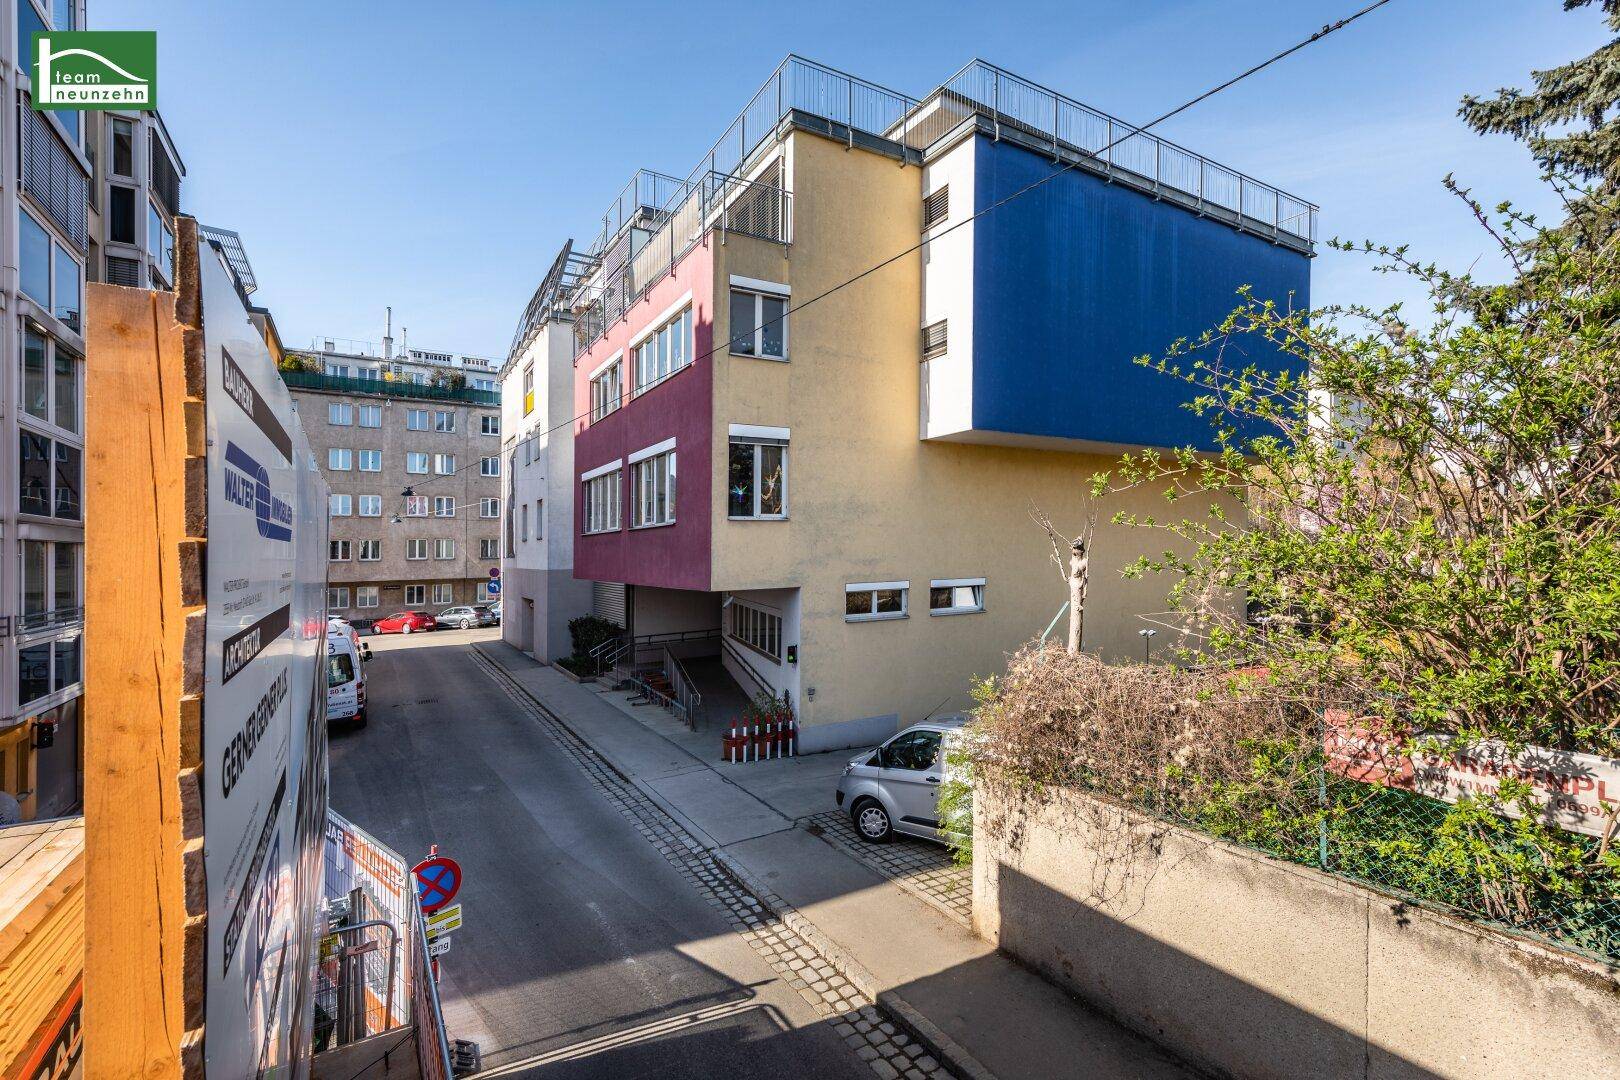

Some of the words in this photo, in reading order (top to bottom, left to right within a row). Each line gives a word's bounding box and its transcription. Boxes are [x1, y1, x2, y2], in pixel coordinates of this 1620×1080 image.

[224, 356, 255, 418] BAUHERR
[224, 467, 254, 511] WALTER
[222, 710, 257, 800] GERNER
[256, 680, 277, 743] GERNER
